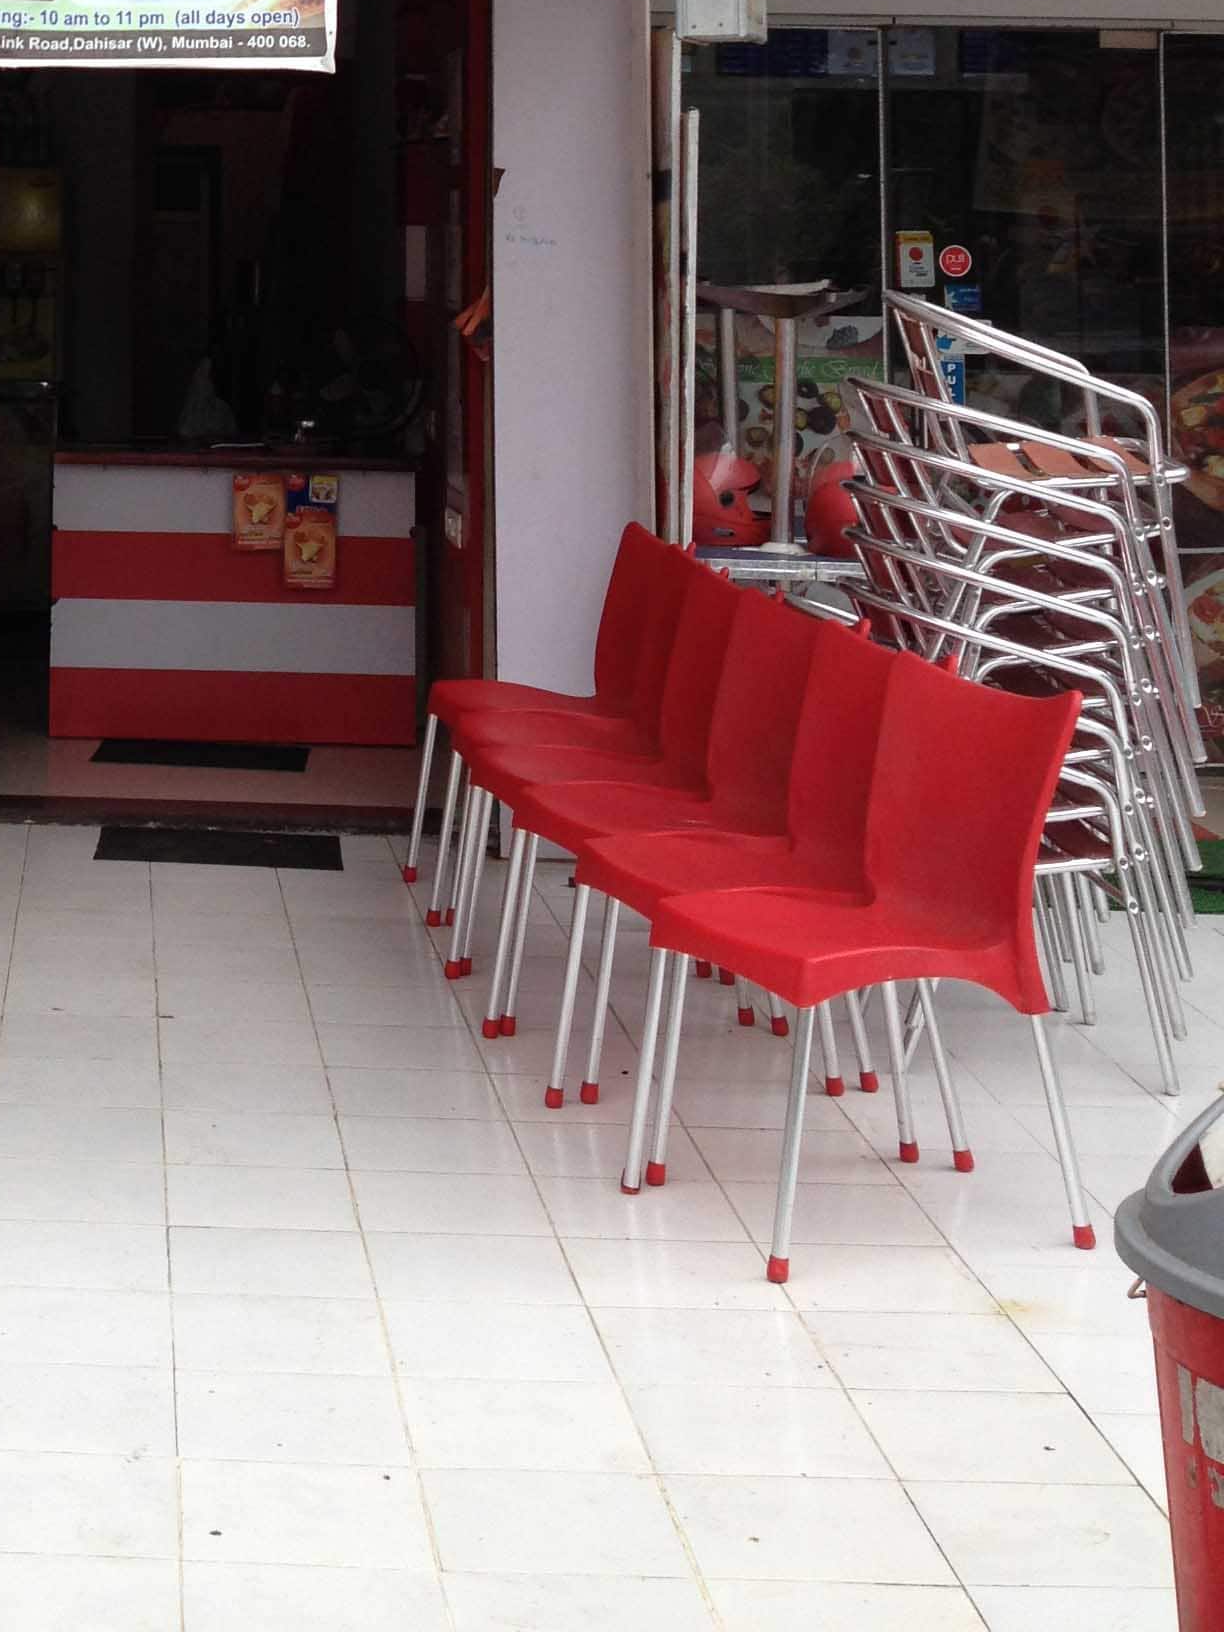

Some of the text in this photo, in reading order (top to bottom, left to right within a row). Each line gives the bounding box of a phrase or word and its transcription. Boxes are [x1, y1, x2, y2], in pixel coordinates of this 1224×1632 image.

[39, 10, 59, 26] 10
[63, 13, 89, 27] am
[93, 11, 111, 27] to
[116, 10, 132, 26] 11
[138, 13, 165, 29] pm
[174, 9, 201, 29] (all
[205, 9, 246, 28] days
[250, 9, 300, 27] open)
[136, 35, 167, 53] (W),
[171, 34, 233, 50] Mumbai
[247, 35, 275, 49] 400
